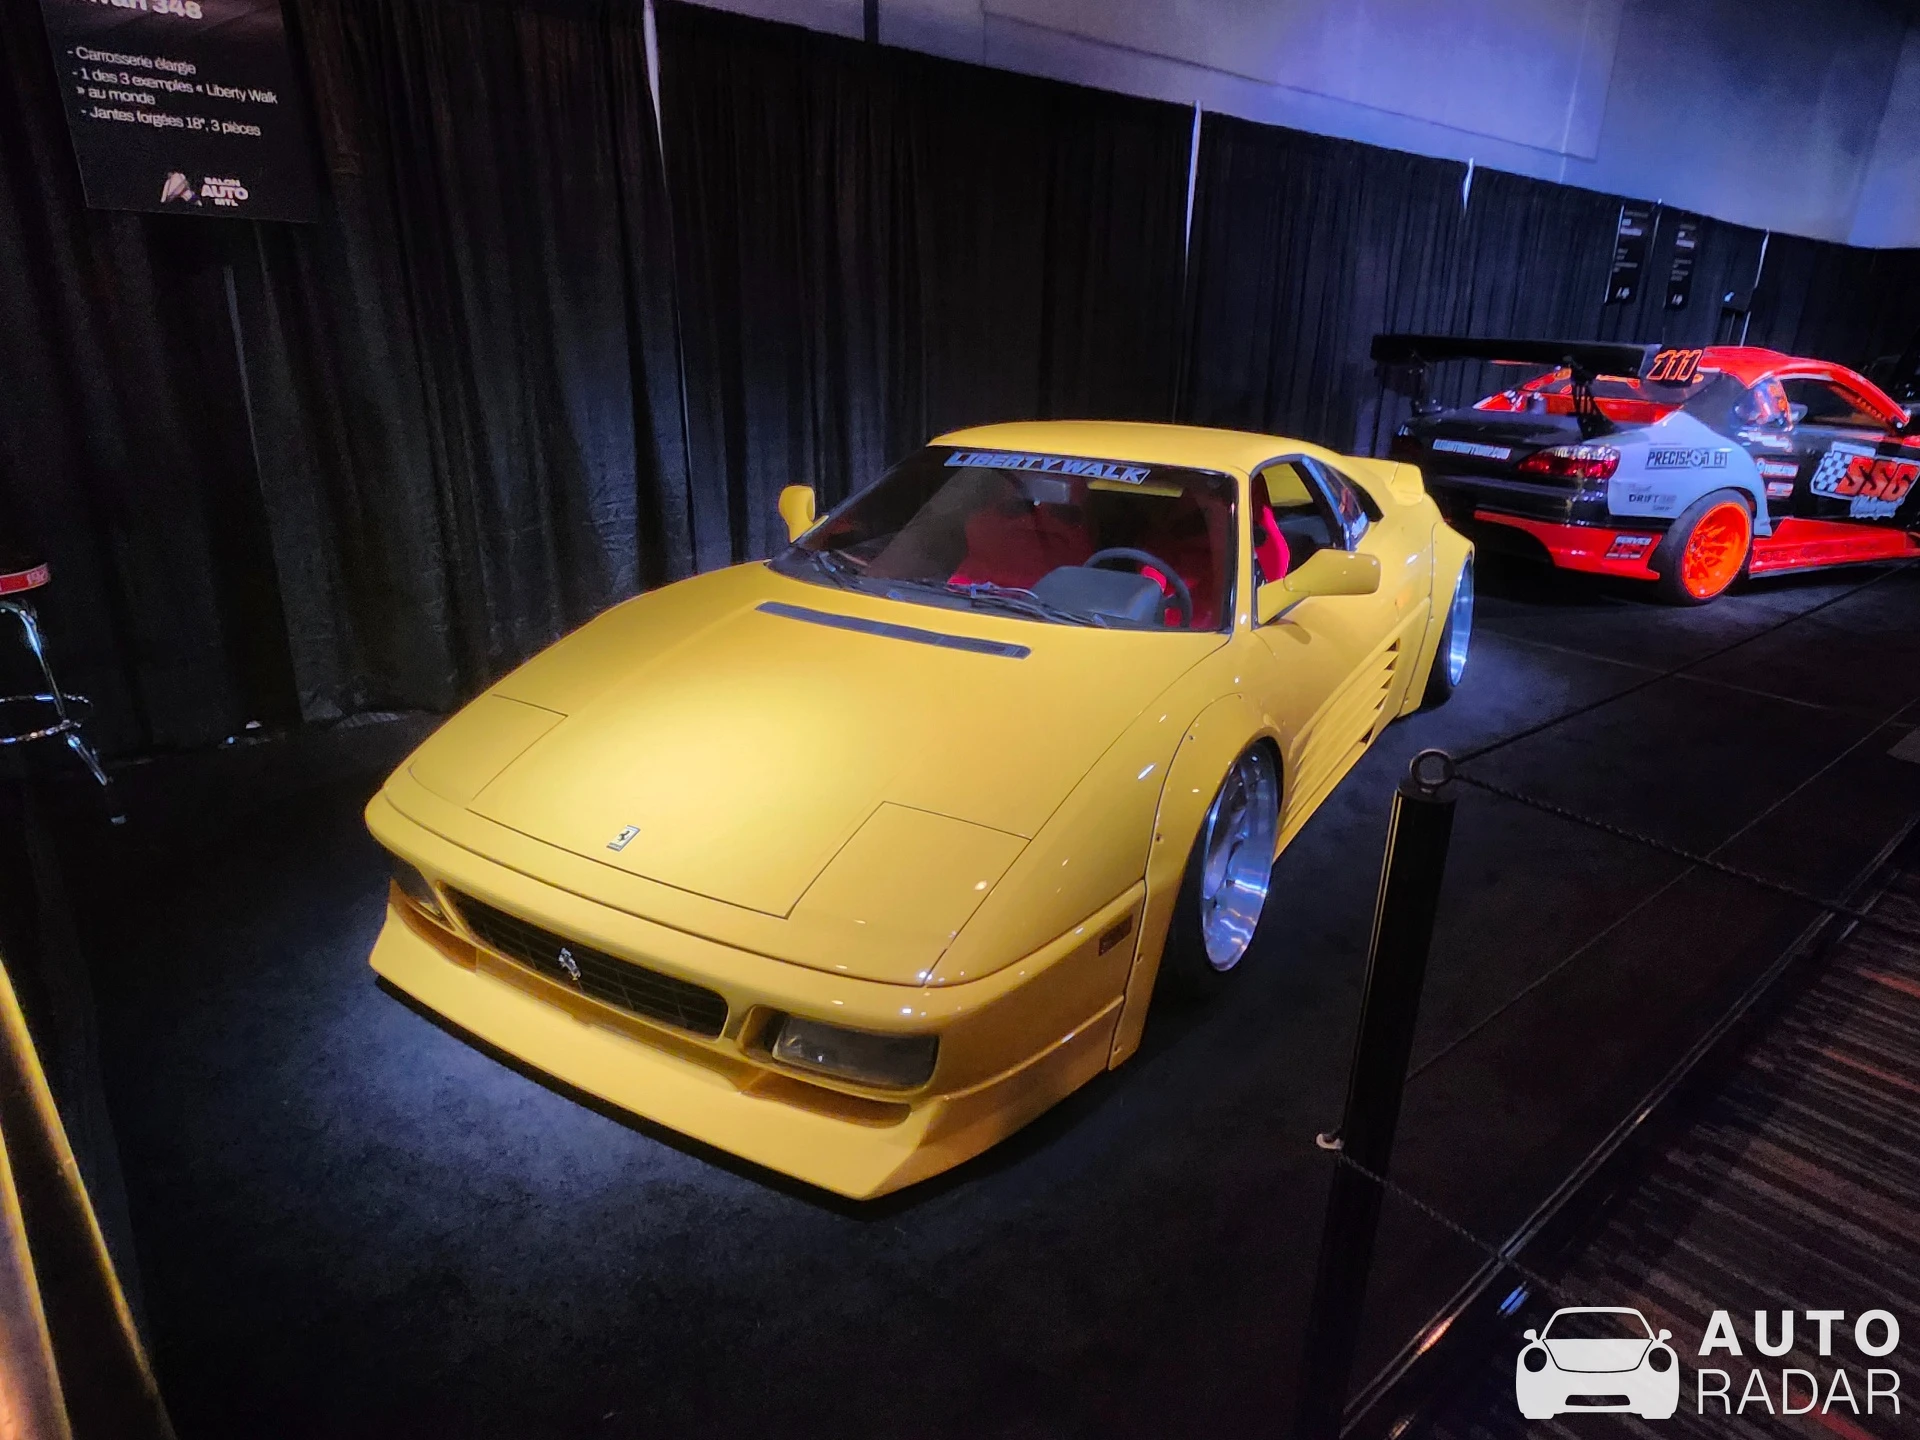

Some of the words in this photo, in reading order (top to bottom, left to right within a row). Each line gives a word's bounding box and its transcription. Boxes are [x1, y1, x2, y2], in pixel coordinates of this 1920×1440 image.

[76, 46, 153, 69] Carrosserie
[154, 57, 196, 75] élargie
[81, 67, 90, 80] 1
[92, 68, 117, 83] des
[120, 72, 130, 85] 3
[131, 75, 194, 93] exemples
[206, 83, 246, 102] Liberty
[247, 88, 278, 104] Walk
[88, 87, 106, 99] au
[108, 90, 156, 105] monde
[89, 105, 135, 122] Jantes
[136, 109, 184, 127] forgées
[210, 119, 220, 131] 3
[222, 120, 262, 136] pièces
[200, 184, 249, 200] AUTO
